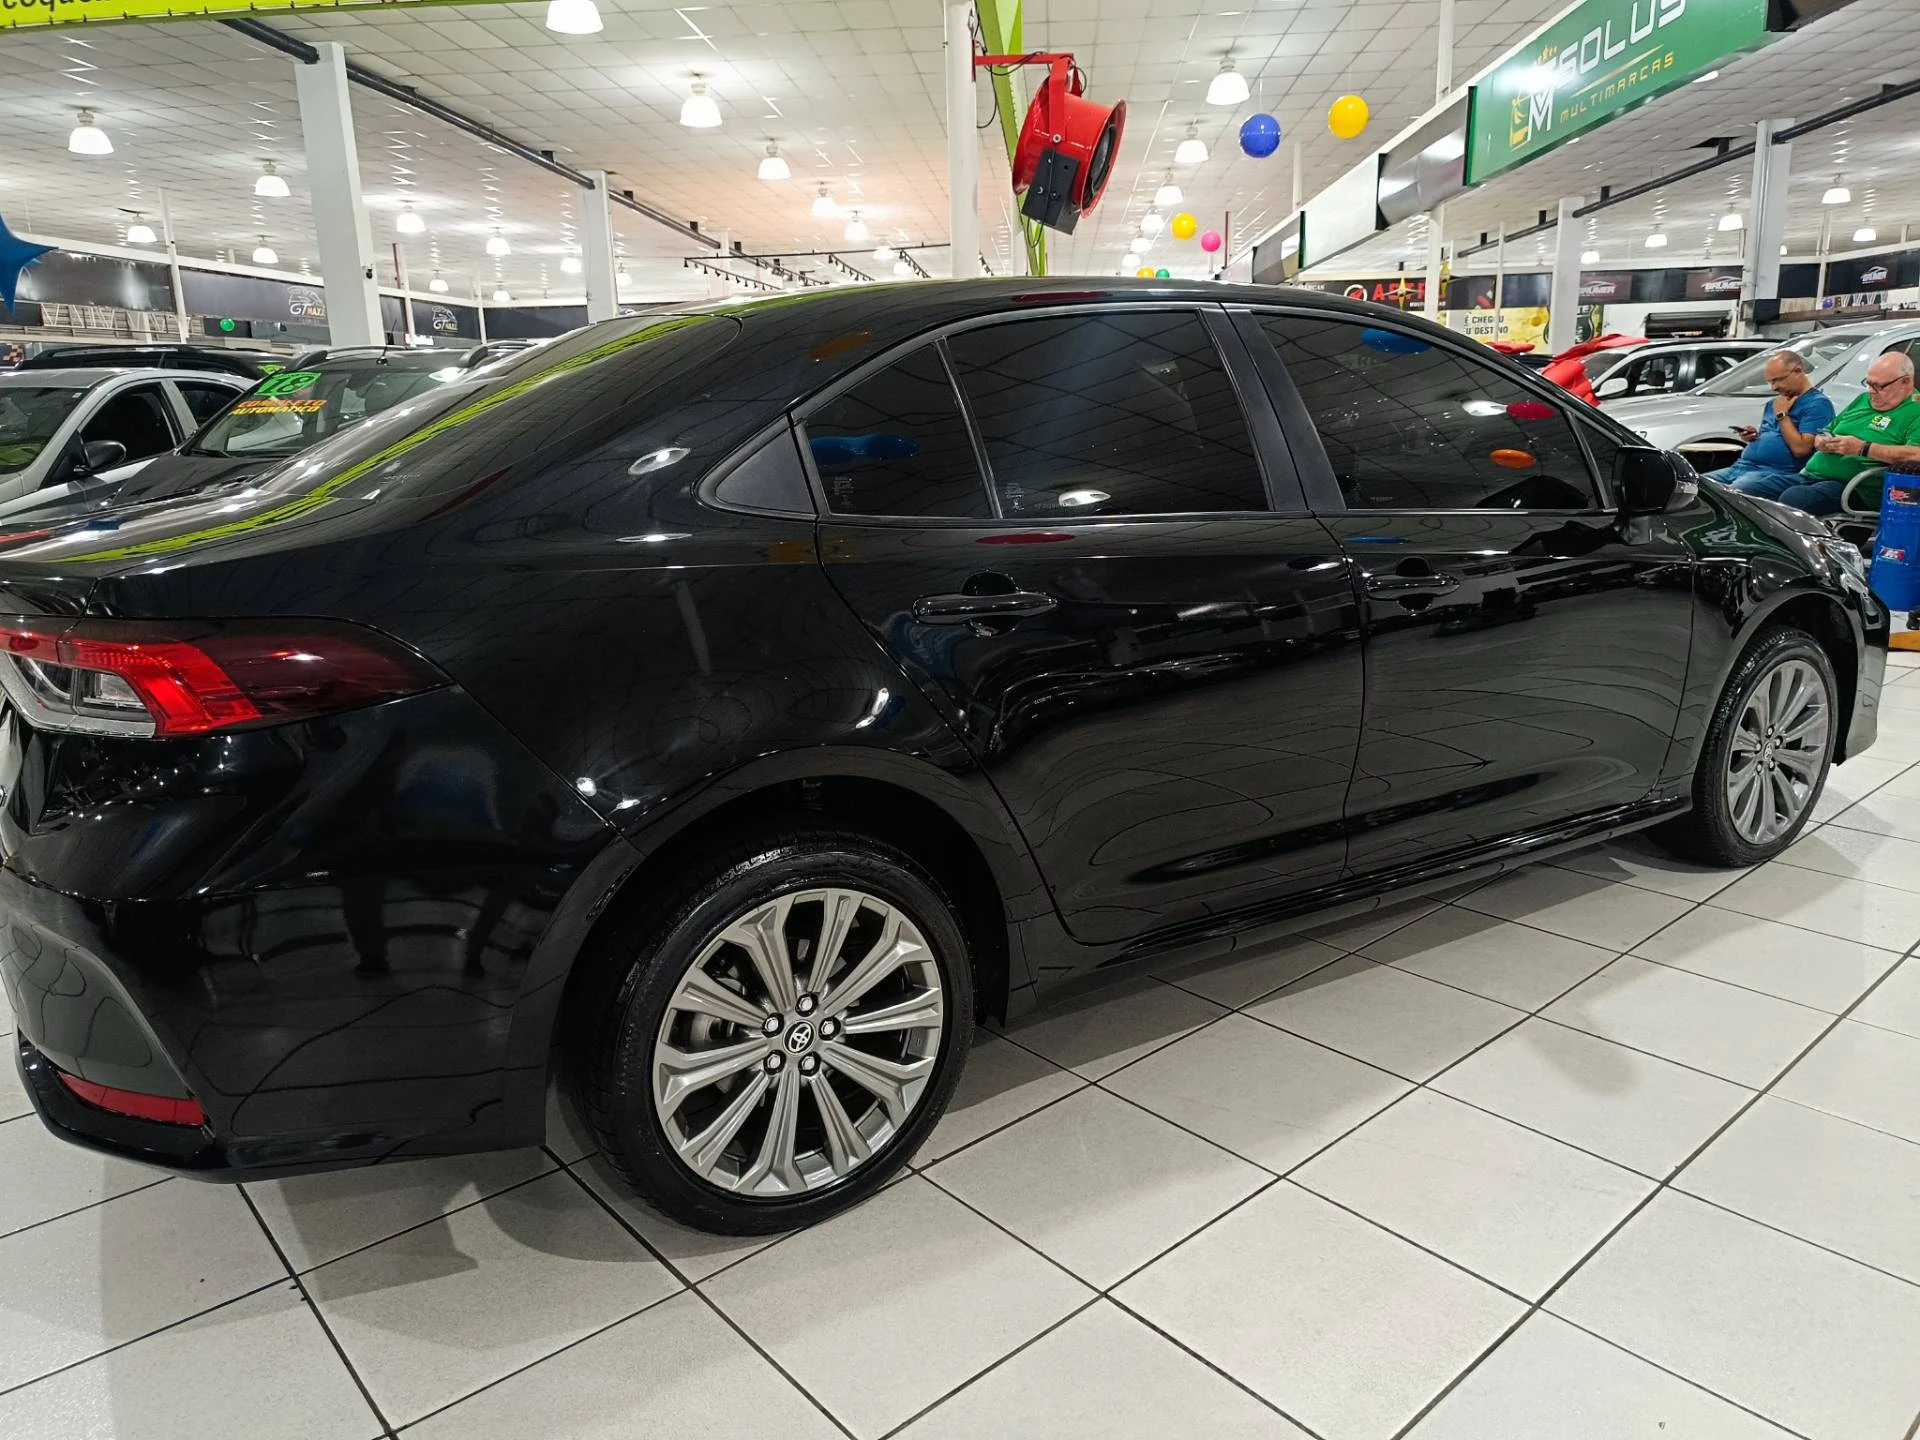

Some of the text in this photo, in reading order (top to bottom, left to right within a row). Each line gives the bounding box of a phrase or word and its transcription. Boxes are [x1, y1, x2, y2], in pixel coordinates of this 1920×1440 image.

[1560, 52, 1675, 124] MULTIMARCAS
[1472, 315, 1504, 324] CHEGU
[1474, 326, 1509, 335] DESTNO
